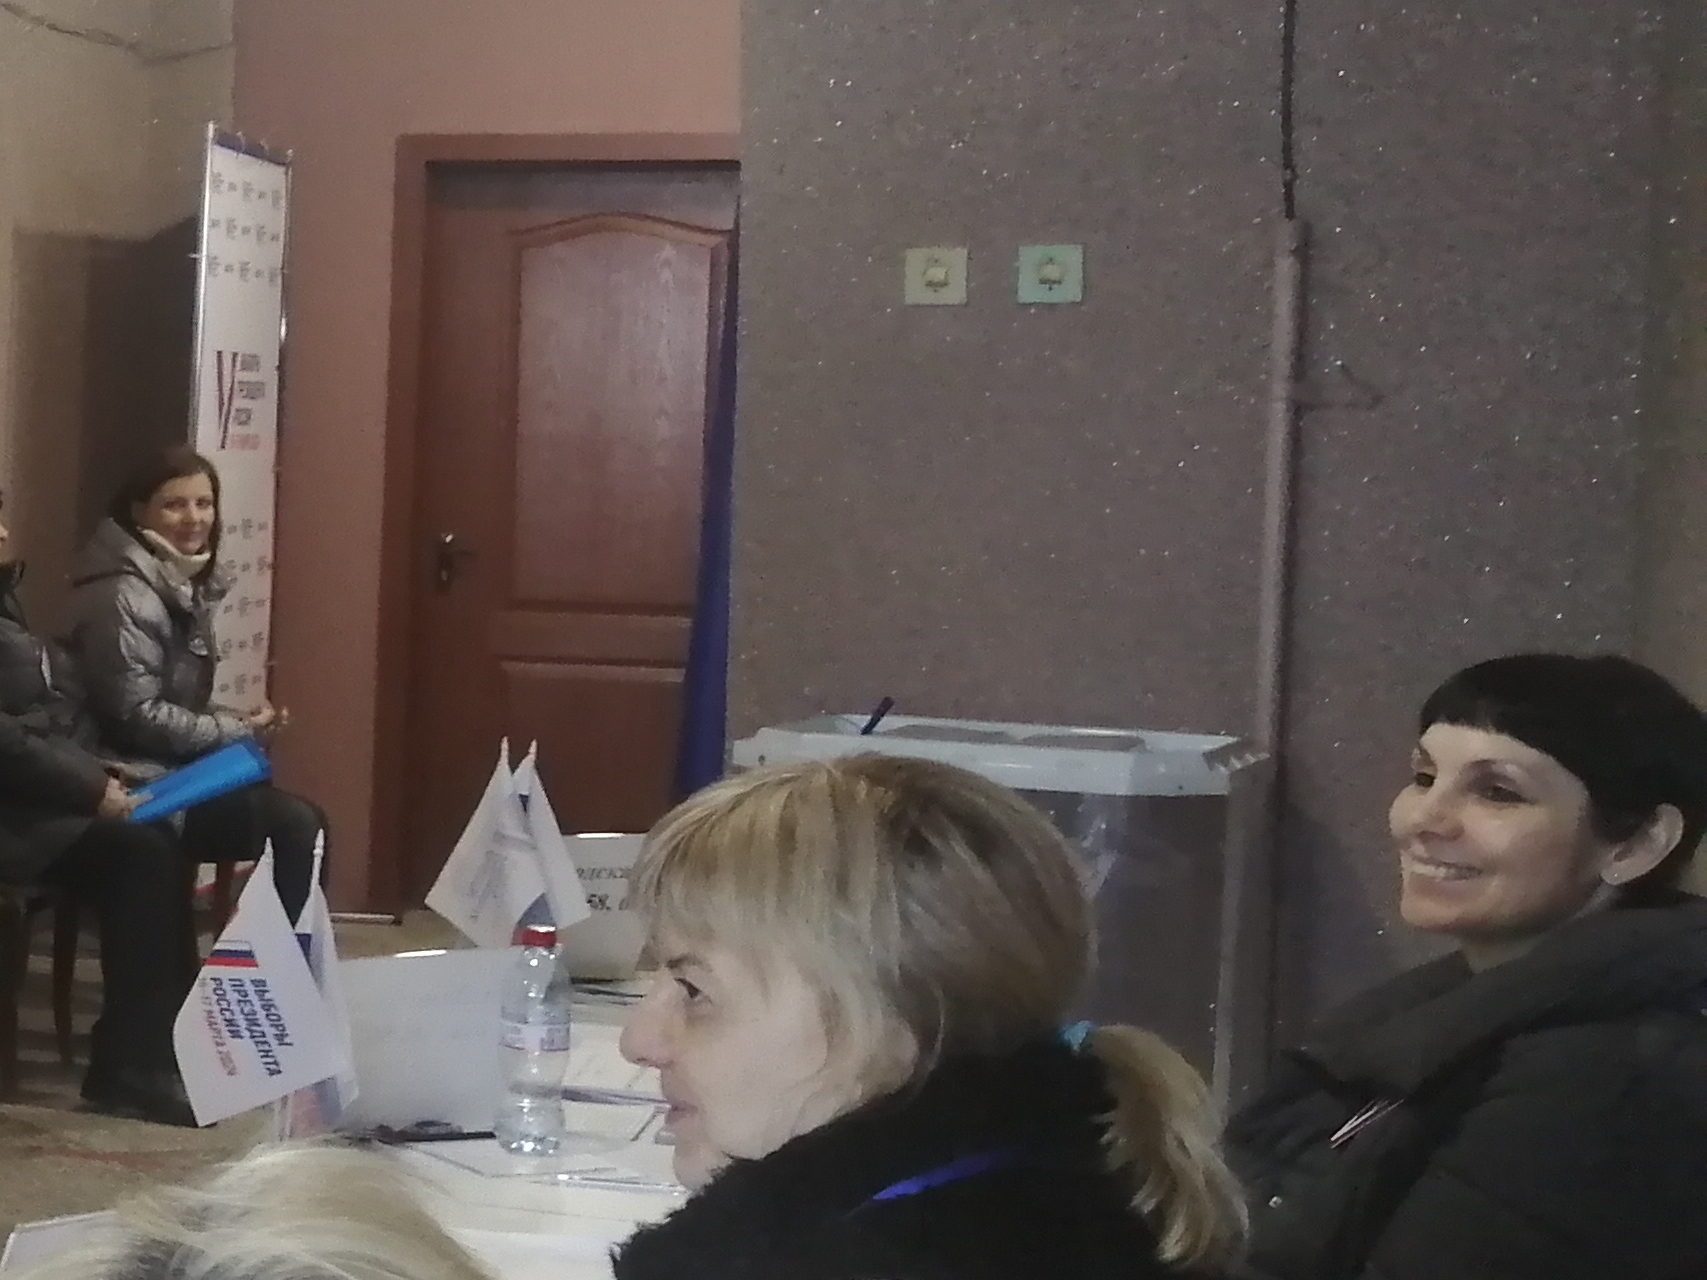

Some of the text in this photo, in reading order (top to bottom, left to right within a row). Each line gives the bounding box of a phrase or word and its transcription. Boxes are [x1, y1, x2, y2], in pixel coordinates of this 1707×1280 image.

[210, 977, 244, 1039] РОССИИ
[228, 978, 283, 1076] ПРЕЗИДЕНТА
[250, 978, 293, 1047] ВЫБОРЫ
